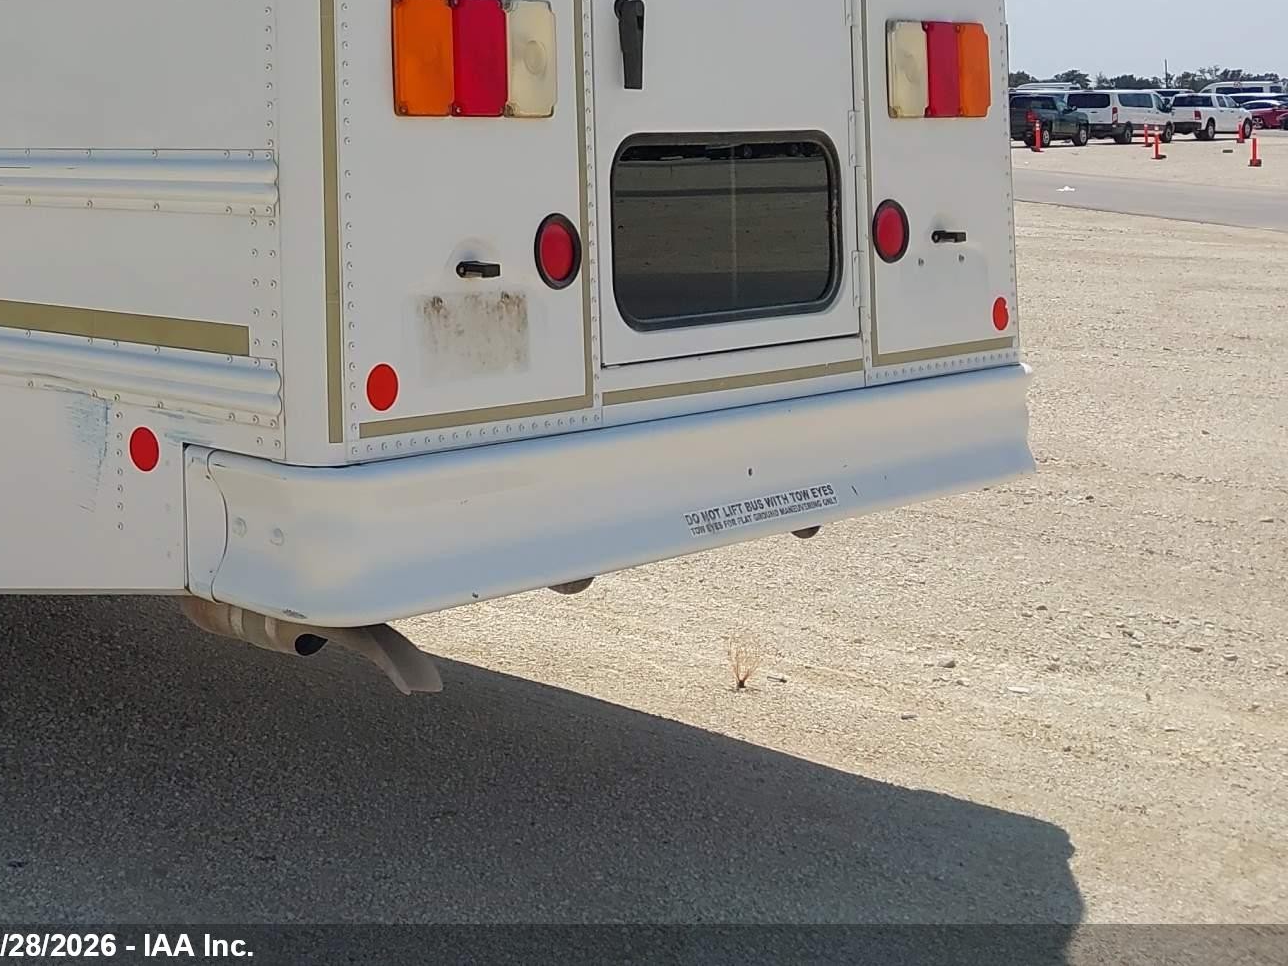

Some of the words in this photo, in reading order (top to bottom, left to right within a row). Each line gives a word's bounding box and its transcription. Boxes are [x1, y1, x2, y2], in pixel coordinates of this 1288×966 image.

[685, 513, 700, 525] DO
[701, 508, 721, 522] NOT
[722, 503, 743, 517] LIFT
[746, 499, 764, 511] BUS
[764, 492, 789, 508] WITH
[789, 488, 811, 502] TOW
[812, 484, 834, 499] EYES
[724, 518, 738, 528] FOR
[738, 514, 753, 525] FLAT
